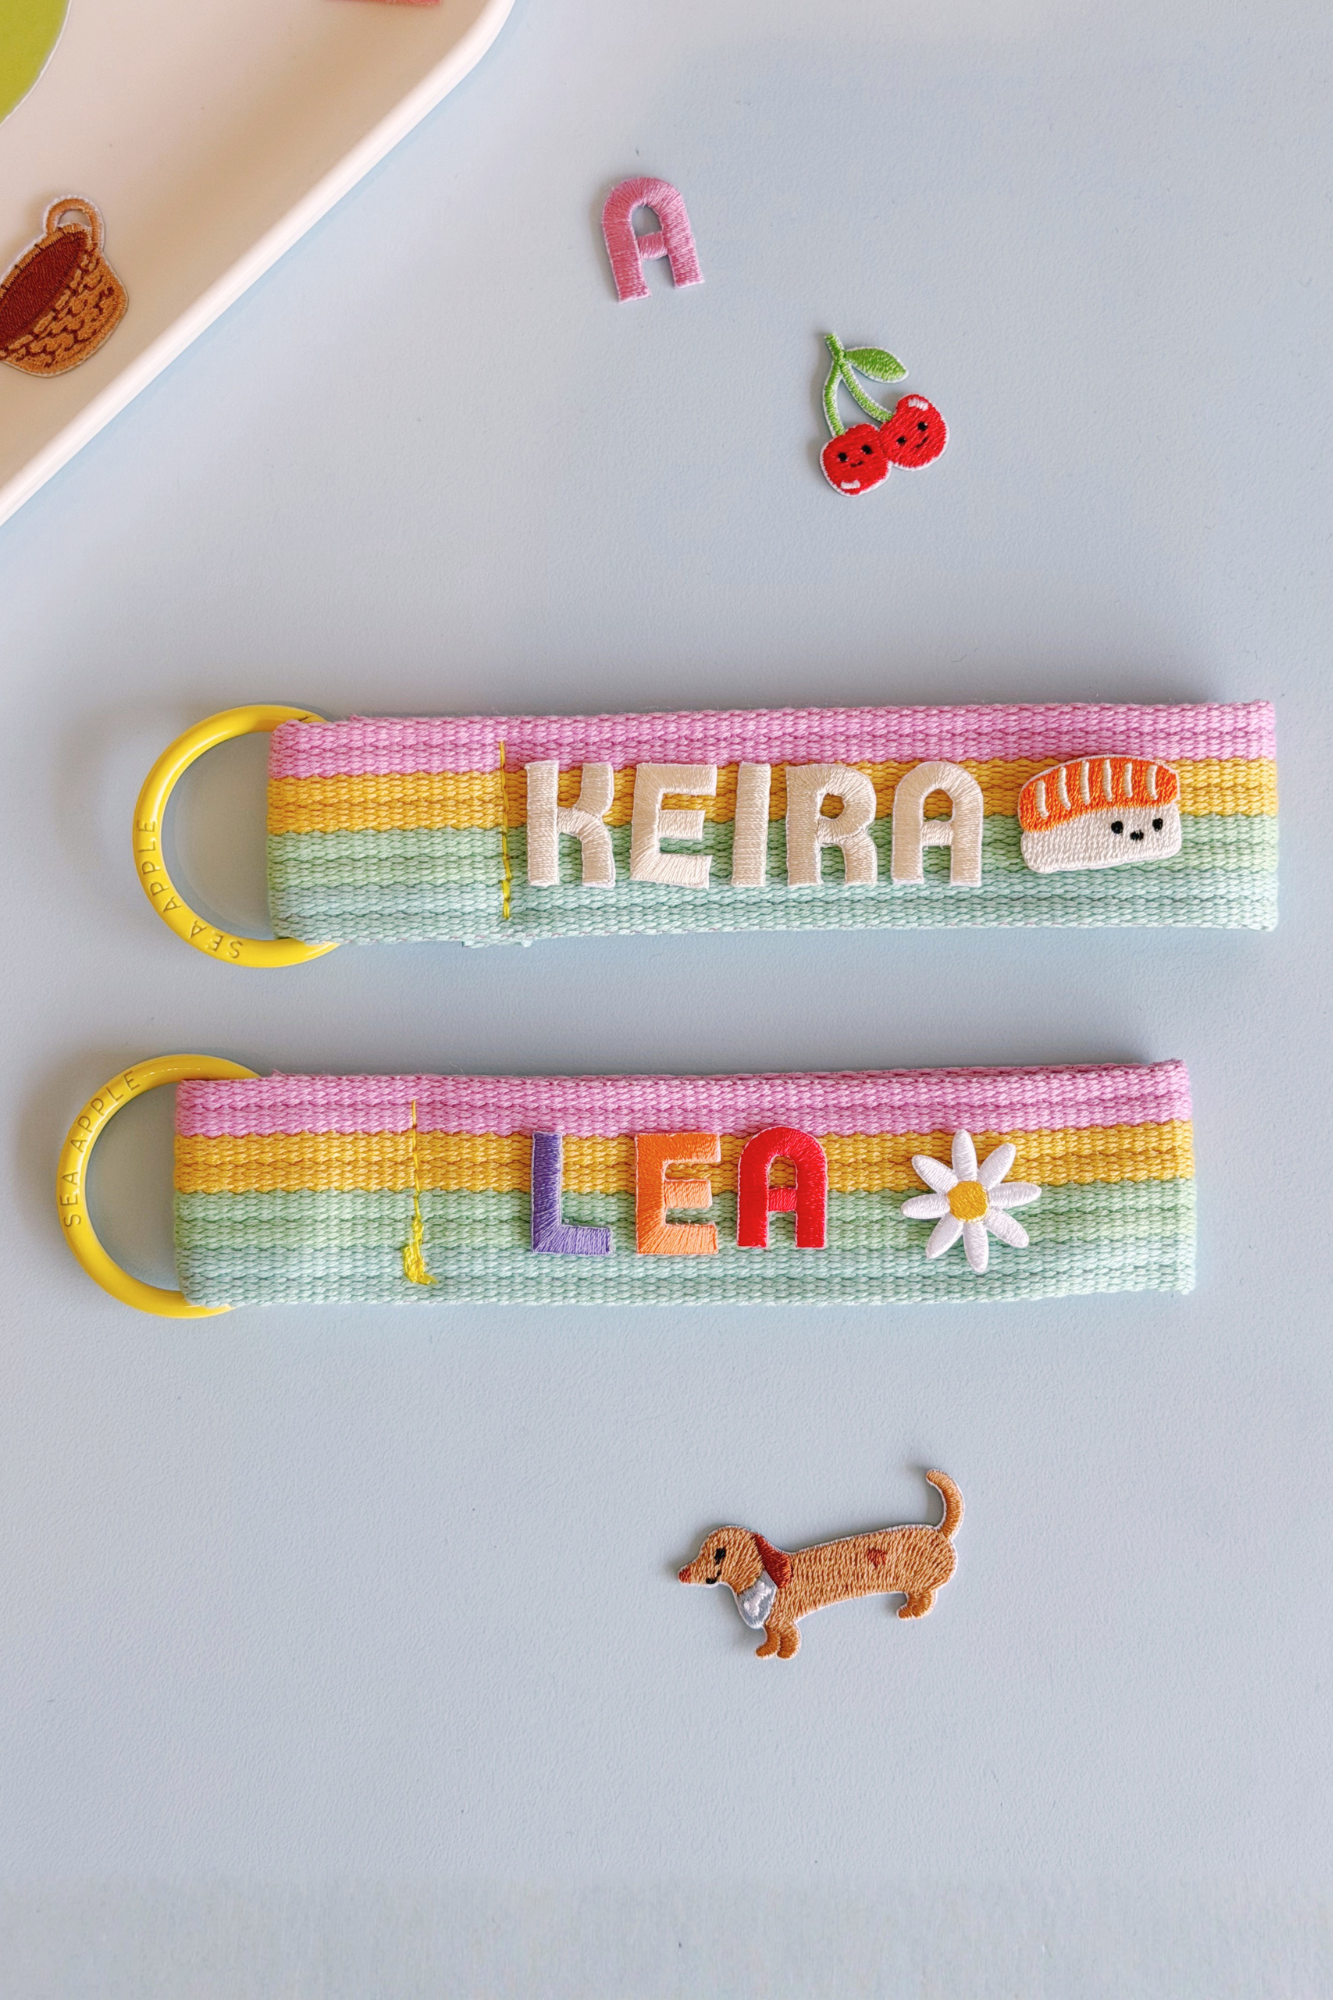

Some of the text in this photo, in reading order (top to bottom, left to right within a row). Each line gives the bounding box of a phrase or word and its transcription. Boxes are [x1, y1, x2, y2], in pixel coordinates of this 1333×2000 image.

[601, 177, 705, 304] A
[526, 760, 984, 888] KEIRA
[137, 820, 243, 959] SEA APPLE
[61, 1071, 140, 1228] SEA APPLE
[531, 1126, 827, 1255] LEA
